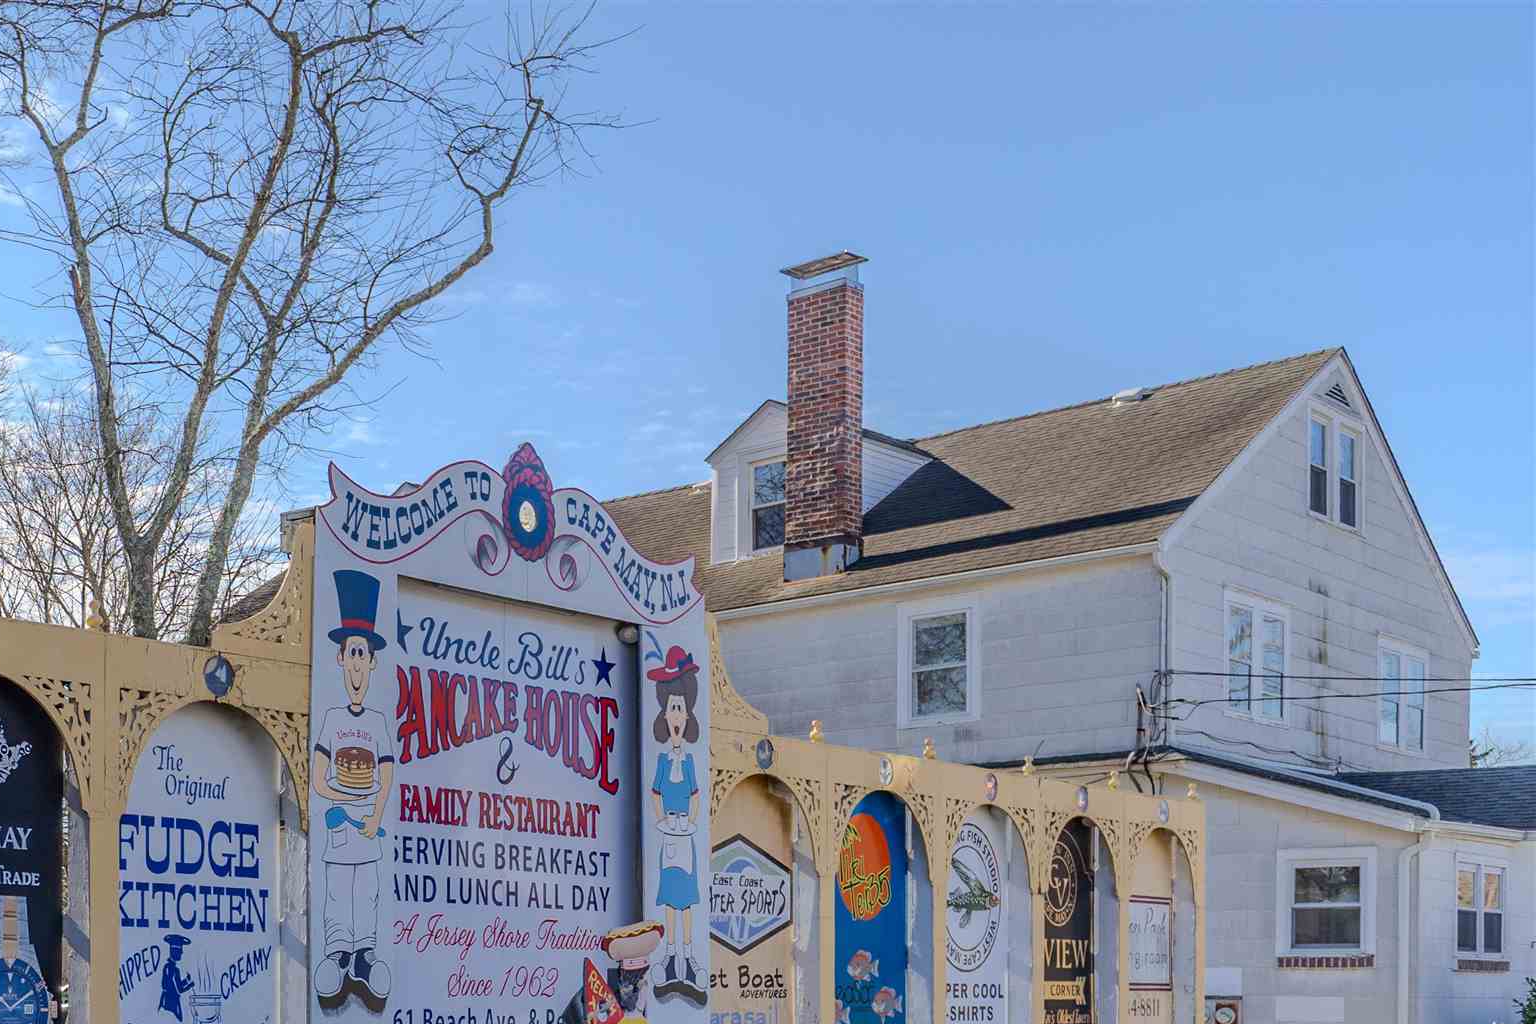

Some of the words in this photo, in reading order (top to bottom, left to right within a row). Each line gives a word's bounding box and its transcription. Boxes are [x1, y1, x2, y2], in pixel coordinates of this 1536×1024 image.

[341, 477, 459, 550] WELCOME
[464, 471, 492, 501] TO
[567, 497, 617, 555] CAPE
[614, 547, 657, 615] MAY,
[420, 617, 501, 670] Uncle
[508, 632, 586, 685] Bill's
[153, 745, 183, 771] The
[524, 684, 620, 796] HOUSE
[496, 736, 520, 785] &
[165, 774, 230, 805] Original
[399, 783, 473, 827] FAMILY
[478, 791, 601, 839] RESTAURANT
[119, 814, 260, 879] FUDGE
[494, 842, 610, 878] BREAKFAST
[968, 830, 983, 849] FISH
[982, 843, 998, 893] STUDIO
[447, 876, 519, 908] LUNCH
[527, 881, 565, 911] ALL
[572, 884, 610, 913] DAY
[712, 873, 733, 887] East
[739, 875, 765, 888] Coast
[741, 880, 786, 916] SPORTS
[119, 880, 269, 932] KITCHEN
[416, 914, 477, 961] Jersey
[482, 915, 530, 950] Shore
[1044, 938, 1089, 969] VIEW
[220, 945, 272, 1000] CREAMY
[448, 964, 493, 999] Since
[498, 966, 559, 998] 1962
[738, 965, 784, 989] Boat
[973, 983, 1005, 999] COOL
[1050, 984, 1081, 997] CORNER
[740, 989, 788, 999] ADVENTURES
